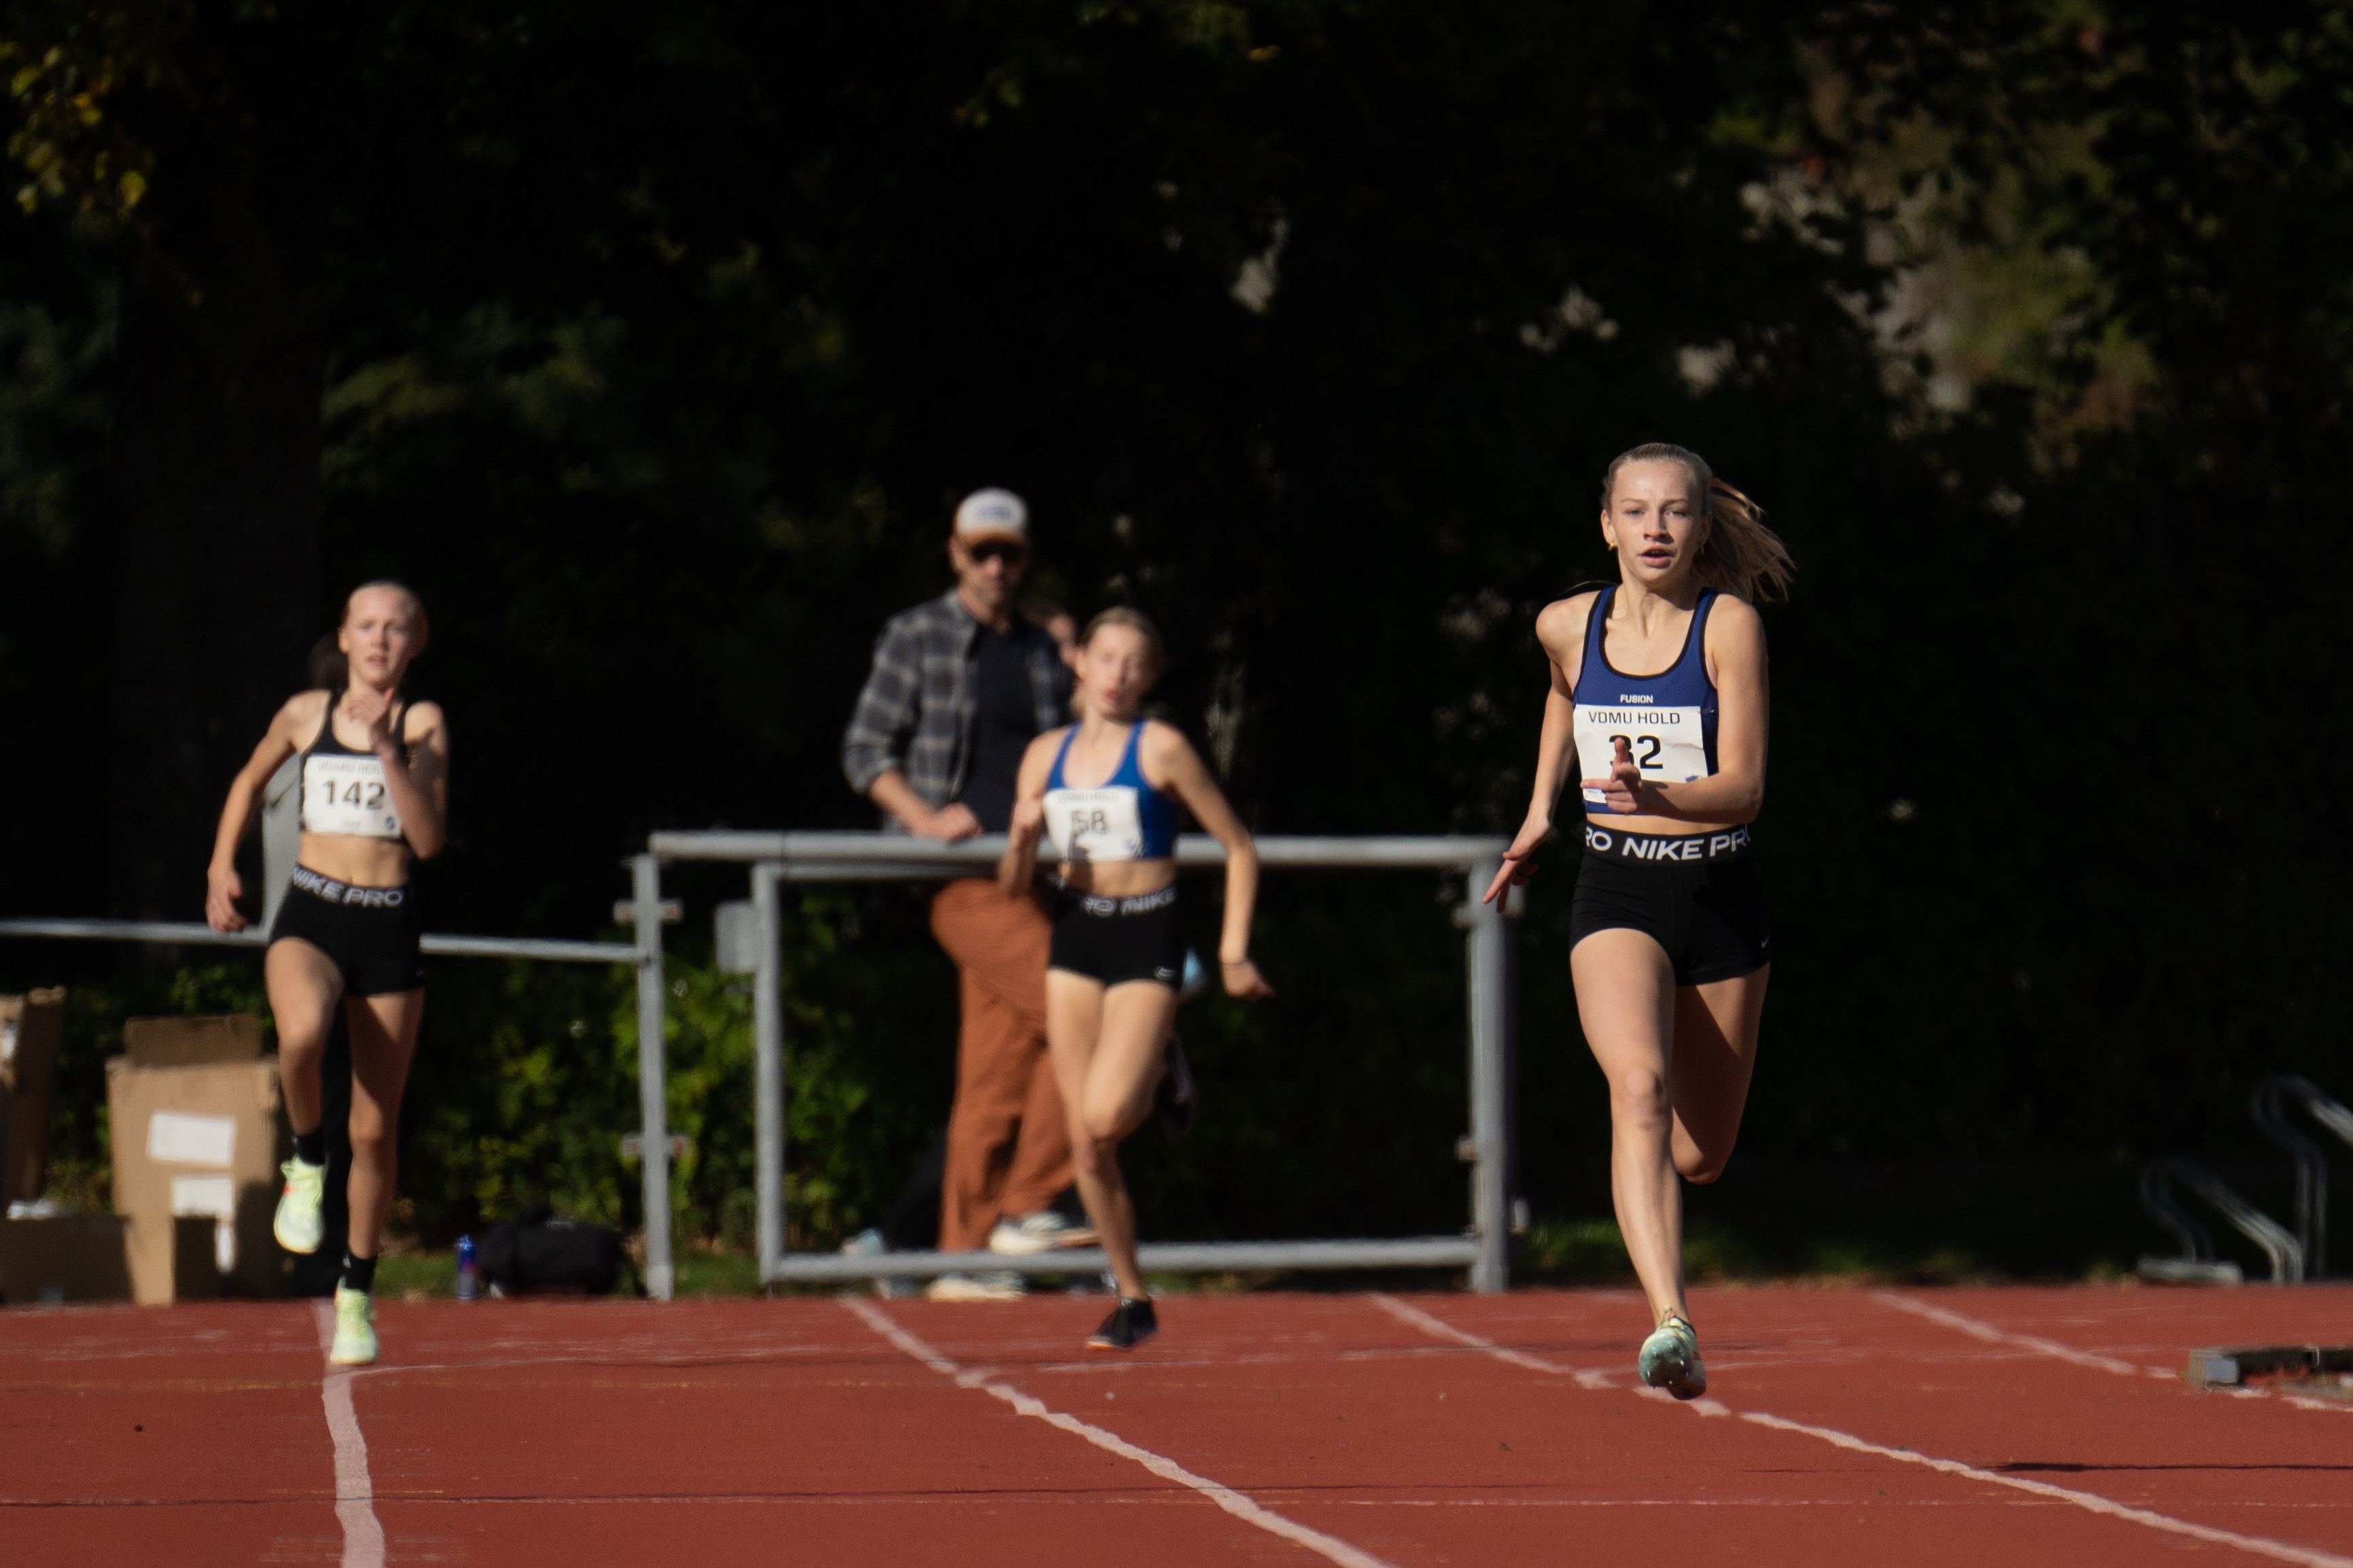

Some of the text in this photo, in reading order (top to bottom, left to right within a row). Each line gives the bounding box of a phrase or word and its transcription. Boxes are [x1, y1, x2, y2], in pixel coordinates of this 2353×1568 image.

[1620, 694, 1653, 704] FUSION
[1588, 710, 1681, 725] VDMU HOLD
[323, 780, 386, 810] 142
[1071, 809, 1109, 835] 58
[1621, 837, 1704, 861] NIKE
[342, 887, 404, 907] PRO
